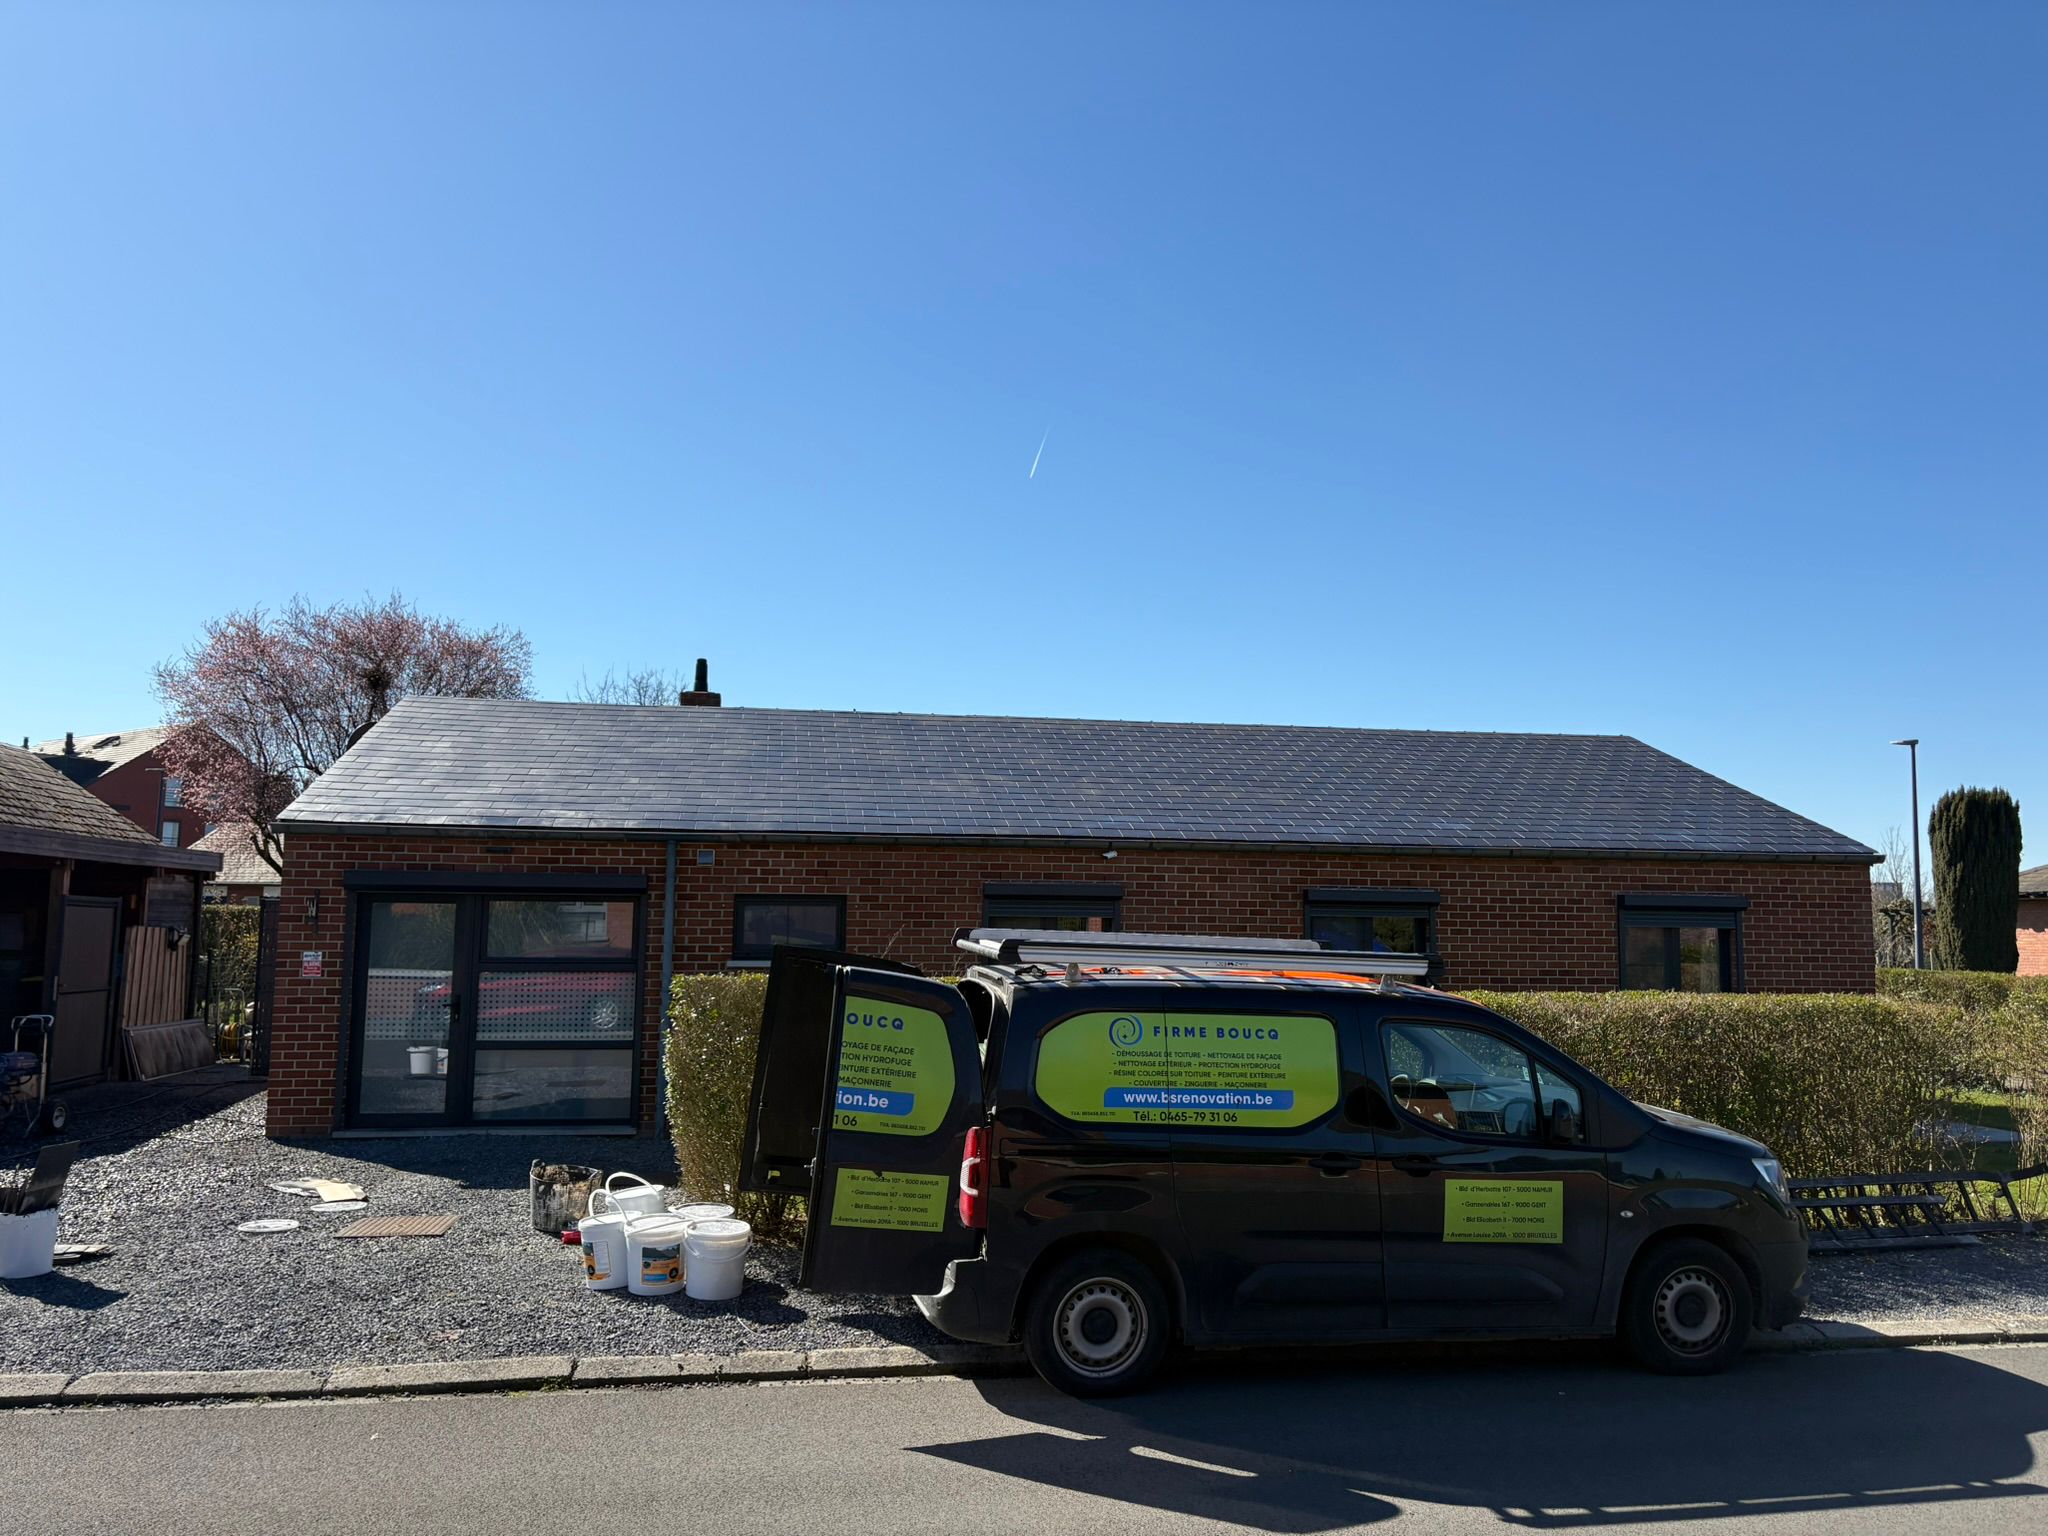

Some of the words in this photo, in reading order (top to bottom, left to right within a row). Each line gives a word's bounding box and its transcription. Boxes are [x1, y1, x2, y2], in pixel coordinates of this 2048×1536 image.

[1153, 1026, 1207, 1038] FIRME
[1217, 1027, 1279, 1040] BOUCQ
[870, 1043, 882, 1051] DE
[883, 1045, 915, 1056] FAÇADE
[1116, 1050, 1162, 1058] DÉMOUSSAGE
[1174, 1051, 1201, 1059] TOITURE
[1207, 1052, 1245, 1060] NETTOYAGE
[1256, 1053, 1282, 1061] FAÇADE
[863, 1055, 912, 1067] HYDROFUGE
[1158, 1060, 1192, 1068] EXTÉRIEUR
[1198, 1061, 1240, 1069] PROTECTION
[1241, 1062, 1281, 1070] HYDROFUGE
[871, 1066, 917, 1079] EXTÉRIEURE
[1113, 1069, 1136, 1077] RÉSINE
[1170, 1070, 1183, 1078] SUR
[1217, 1071, 1248, 1079] PEINTURE
[1249, 1071, 1286, 1080] EXTÉRIEURE
[1133, 1079, 1178, 1087] COUVERTURE
[1184, 1080, 1218, 1088] ZINGUERIE
[1224, 1081, 1268, 1089] MAÇONNERIE
[1123, 1092, 1273, 1105] www.bsrenovation.be
[841, 1115, 857, 1127] 06
[1133, 1111, 1157, 1122] Tél.:
[1159, 1111, 1207, 1122] 0465-79
[1209, 1112, 1220, 1122] 31
[1223, 1112, 1238, 1123] 06
